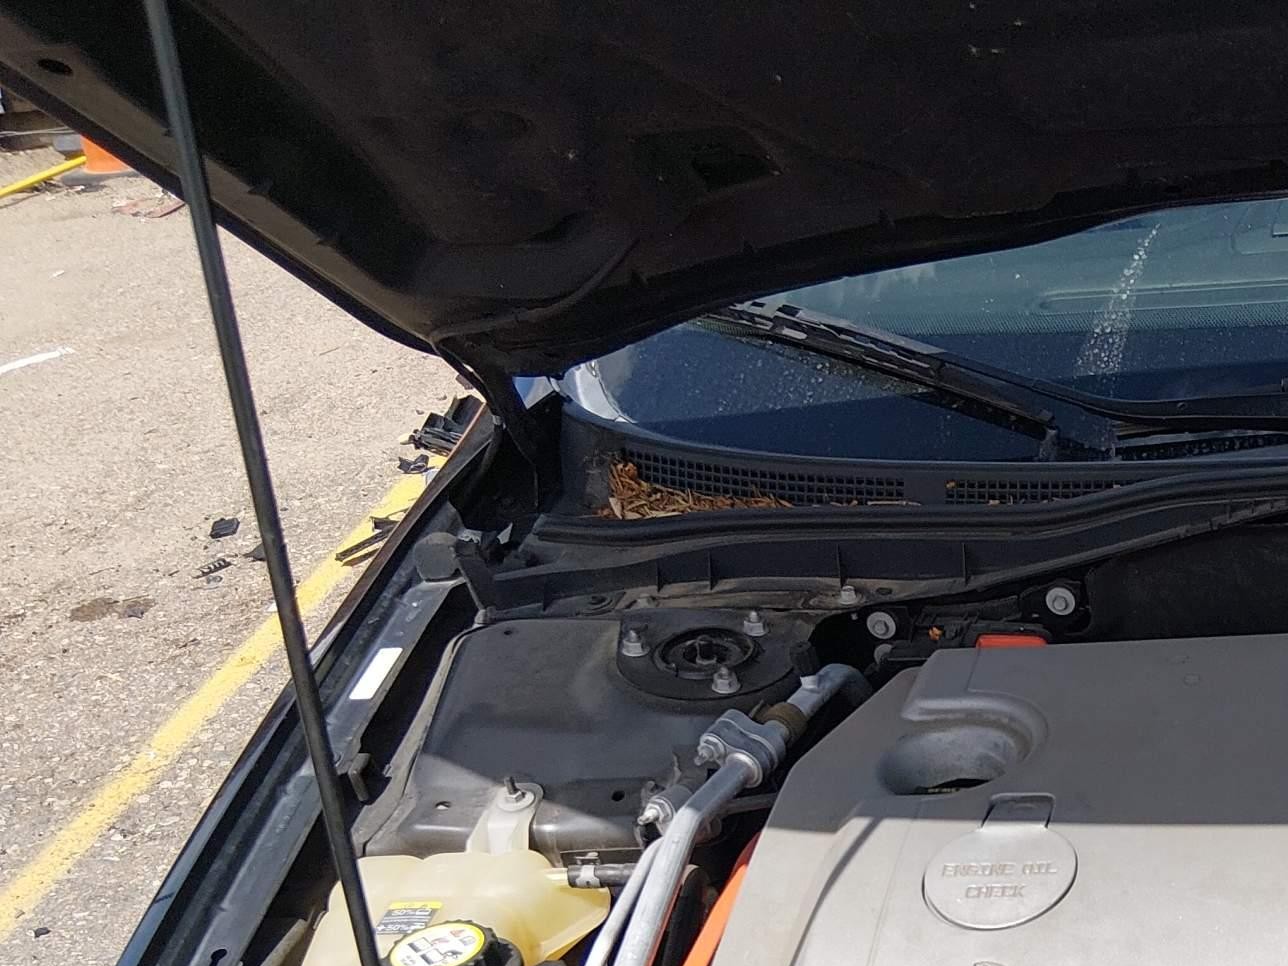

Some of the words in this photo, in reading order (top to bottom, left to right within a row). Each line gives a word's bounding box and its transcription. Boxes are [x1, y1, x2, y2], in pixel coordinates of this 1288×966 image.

[942, 863, 1015, 877] ENGINE
[1022, 861, 1058, 875] OIL
[964, 883, 1025, 899] CHECK
